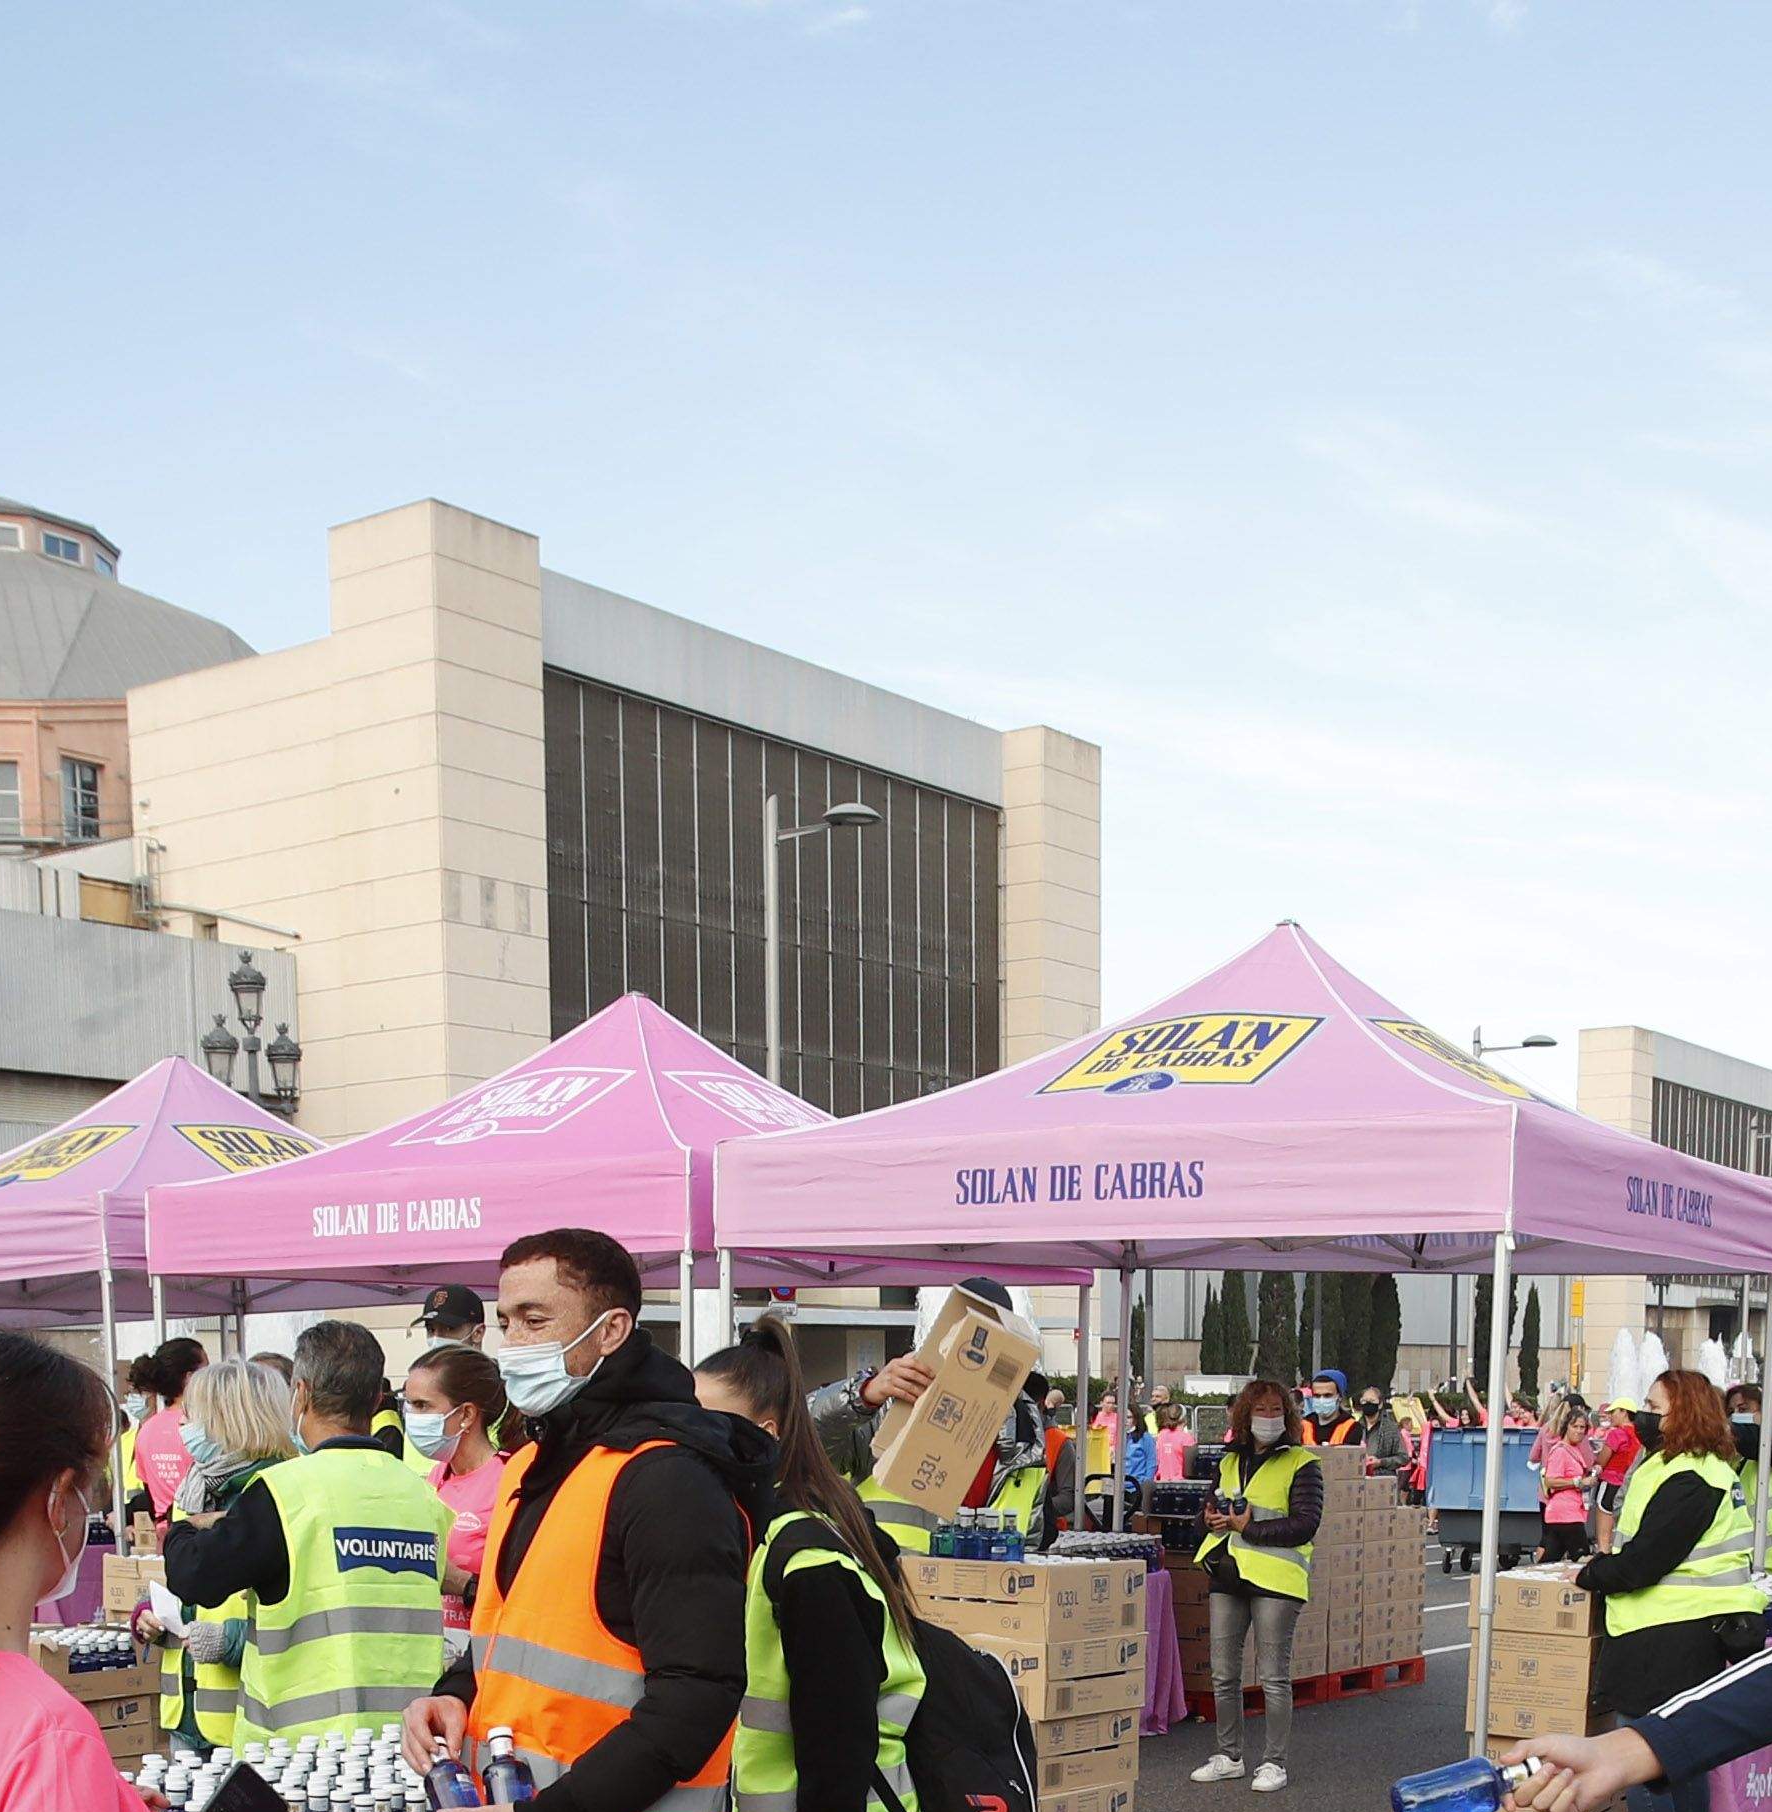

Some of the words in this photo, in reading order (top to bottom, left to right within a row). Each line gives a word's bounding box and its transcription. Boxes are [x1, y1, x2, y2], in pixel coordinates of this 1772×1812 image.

[1107, 1020, 1291, 1057] SOLAN
[1084, 1056, 1130, 1075] DE
[1131, 1050, 1261, 1070] CABRAS
[197, 1129, 311, 1157] SOLAN
[956, 1166, 1038, 1206] SOLAN
[1049, 1164, 1082, 1202] DE
[1094, 1160, 1205, 1201] CABRAS
[312, 1203, 369, 1238] SOLAN
[375, 1202, 400, 1234] DE
[406, 1196, 482, 1232] CABRAS
[1626, 1176, 1659, 1217] SOLAN
[1662, 1182, 1674, 1220] DE
[1677, 1187, 1713, 1228] CABRAS
[167, 1462, 178, 1470] LA
[335, 1538, 436, 1562] VOLUNTARIS
